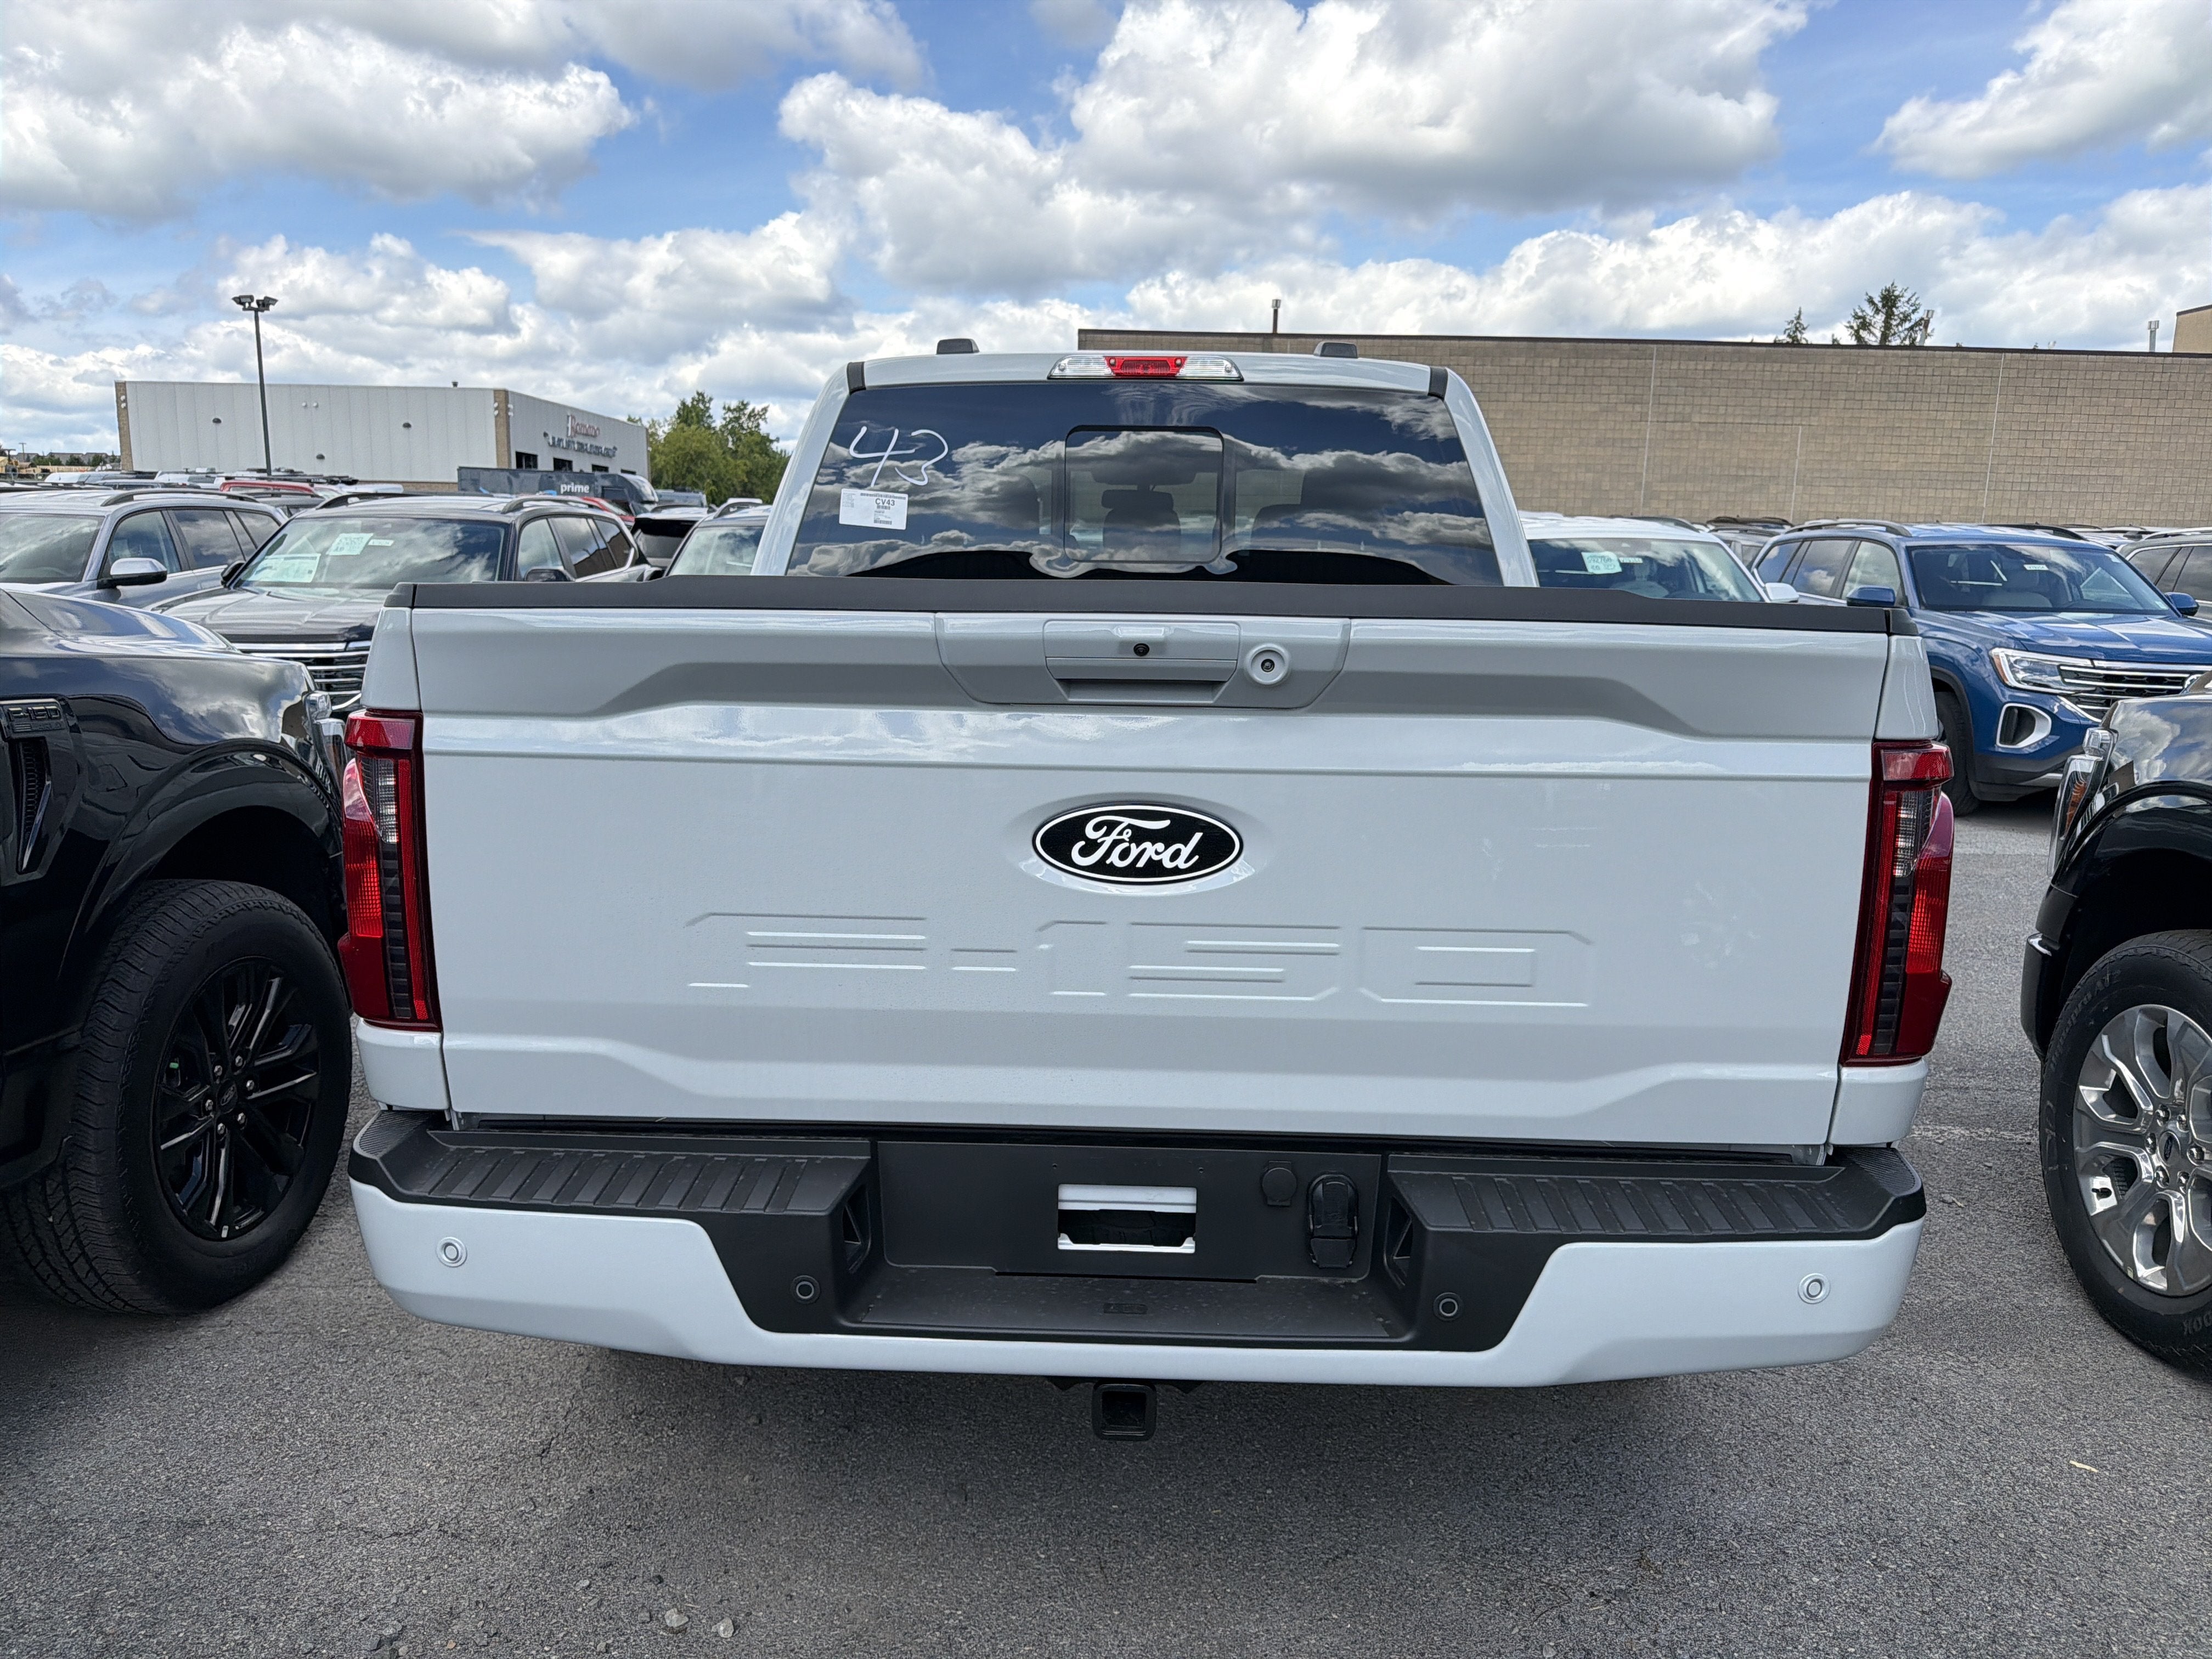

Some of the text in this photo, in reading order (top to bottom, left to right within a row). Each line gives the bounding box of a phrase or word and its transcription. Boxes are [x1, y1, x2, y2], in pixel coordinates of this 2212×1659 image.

[560, 482, 589, 494] prime
[8, 706, 61, 720] F-150
[1071, 816, 1203, 869] Ford
[685, 912, 1593, 1007] F-150
